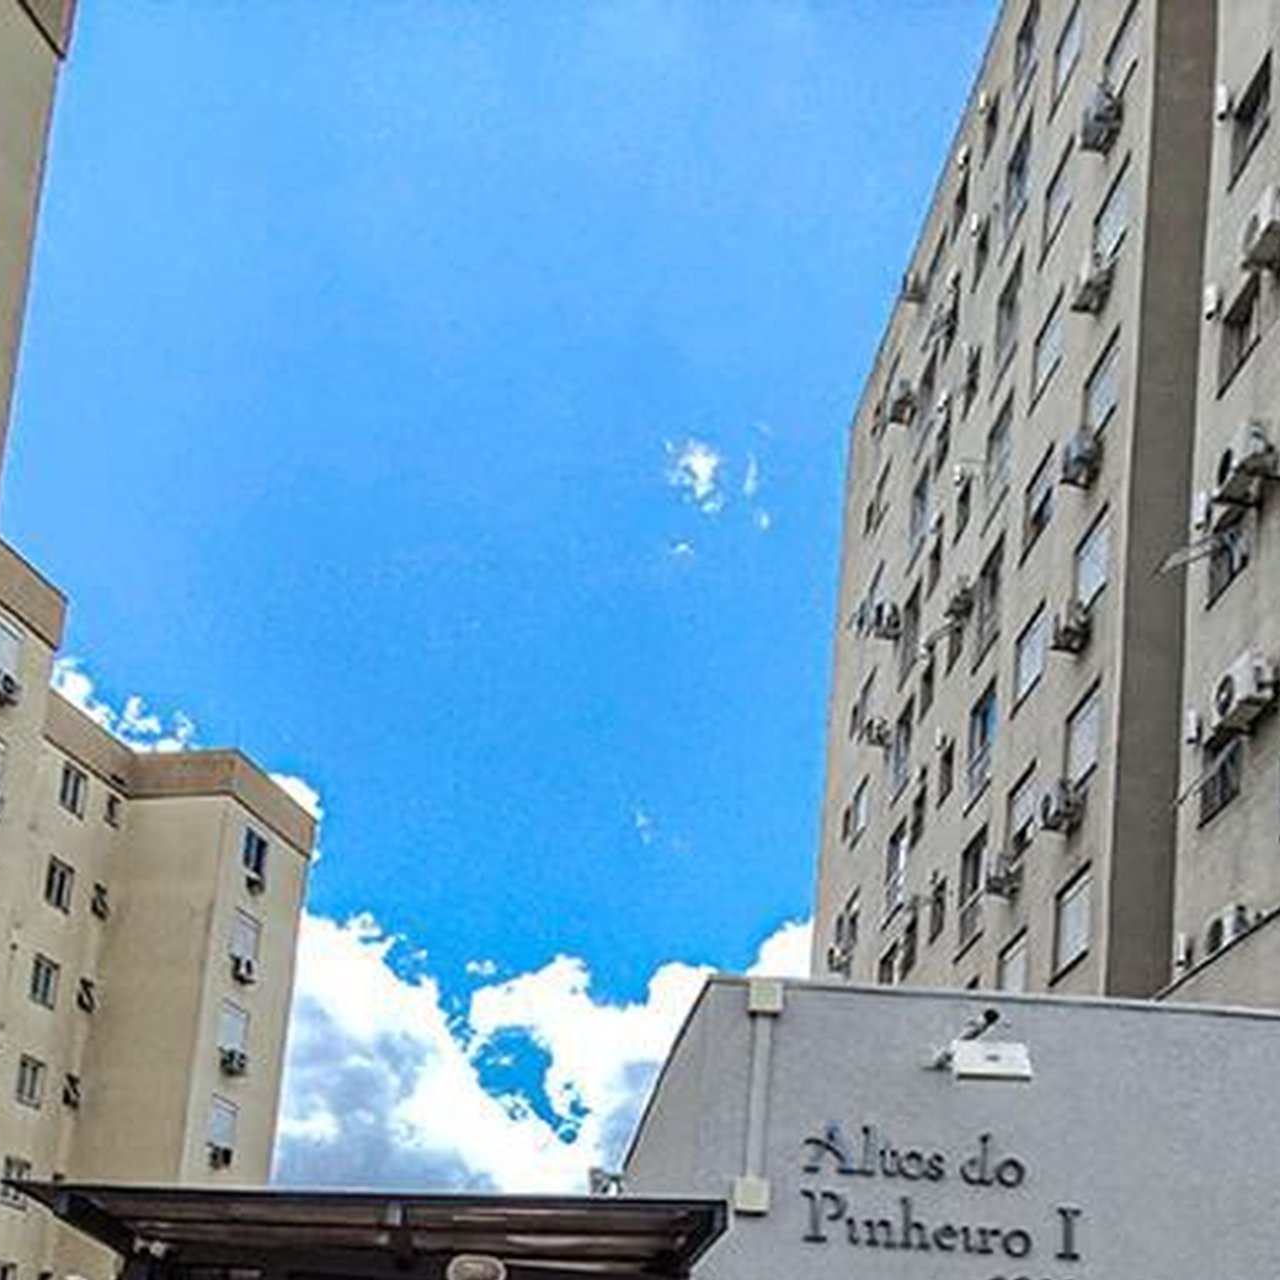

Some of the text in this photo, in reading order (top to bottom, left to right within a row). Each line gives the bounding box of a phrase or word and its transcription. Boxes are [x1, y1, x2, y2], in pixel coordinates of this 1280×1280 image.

[803, 1121, 1026, 1188] Altos do
[800, 1189, 1082, 1261] Pinheiro I
